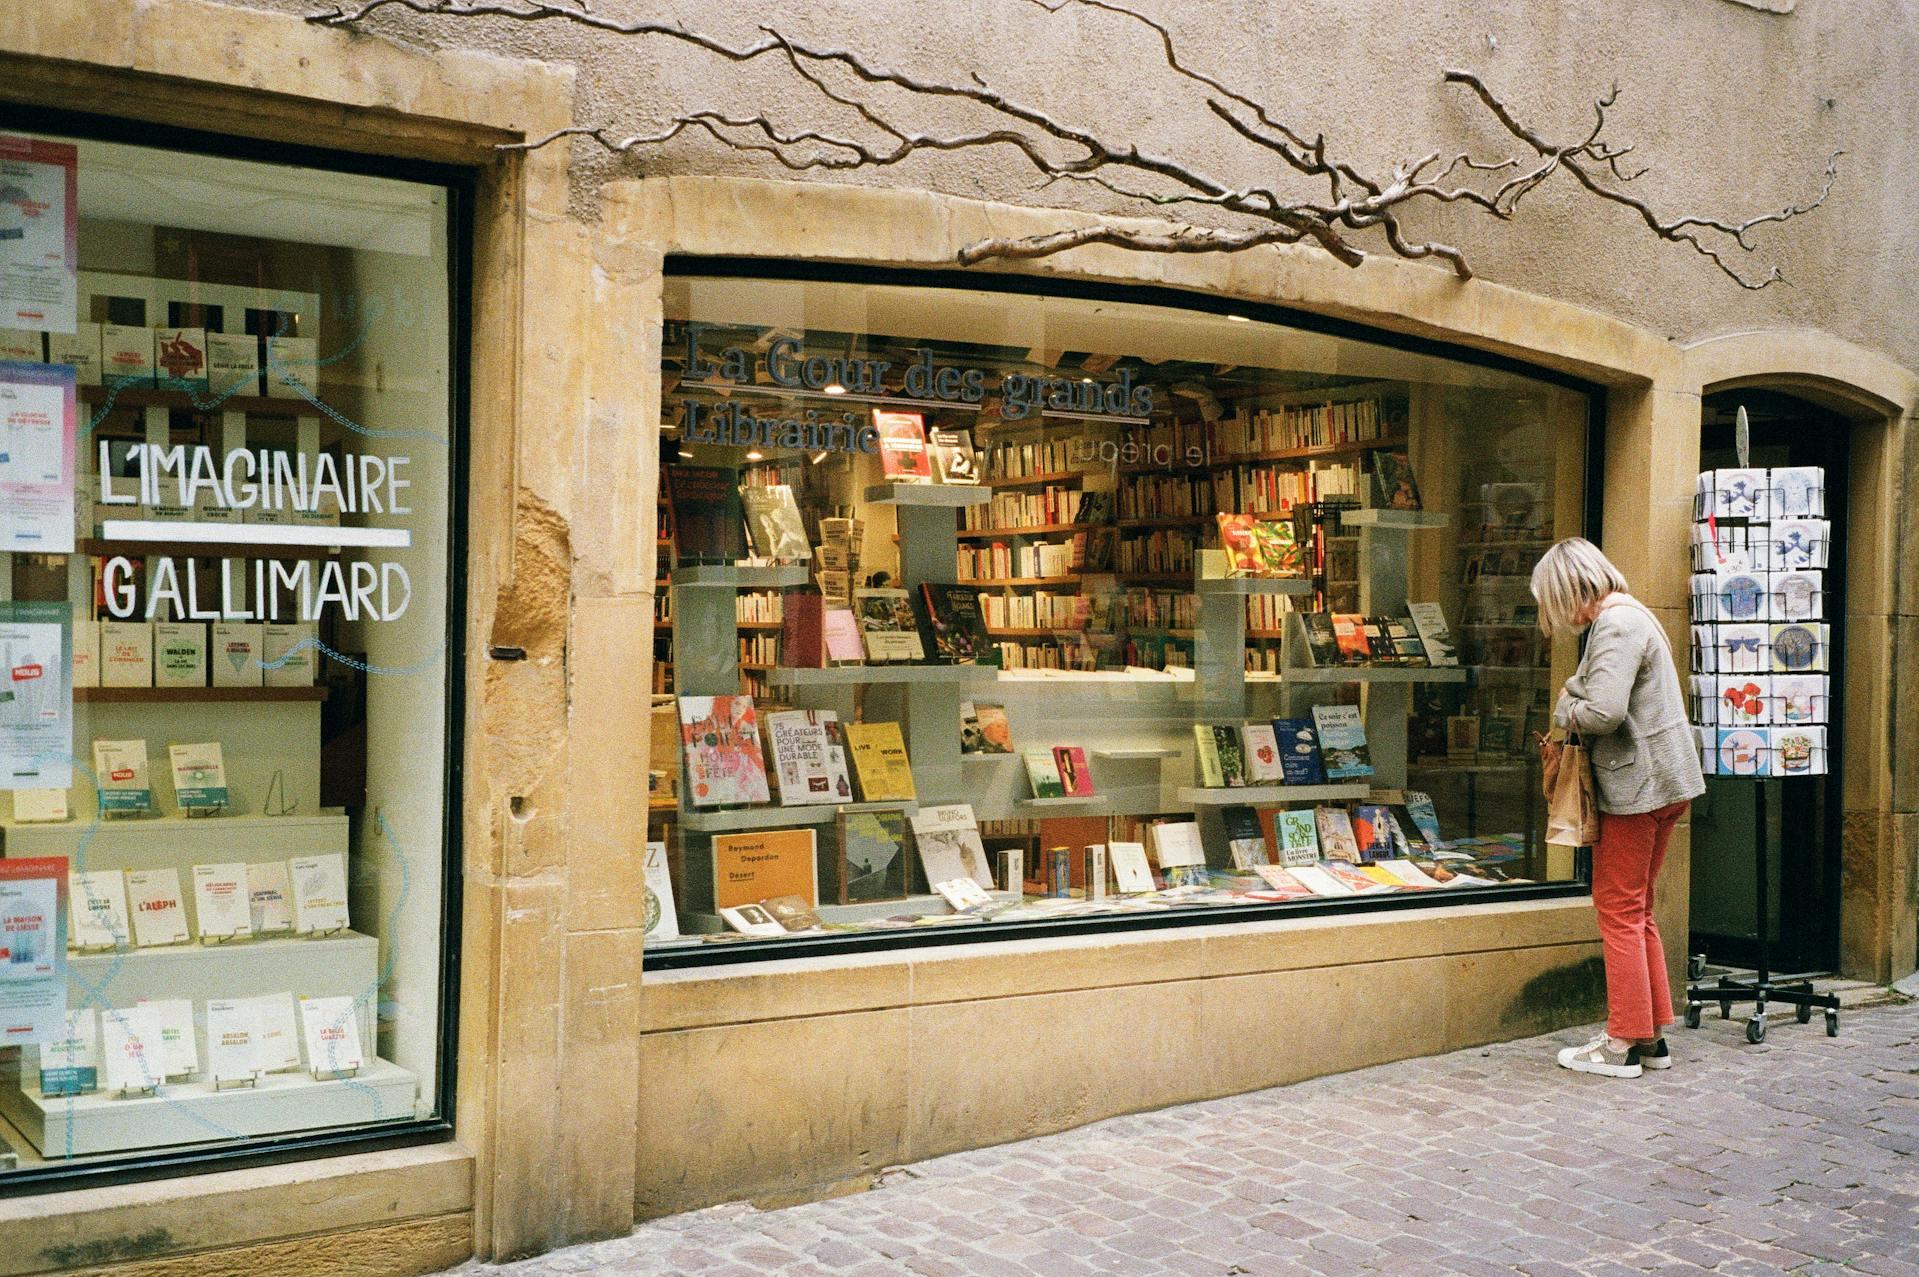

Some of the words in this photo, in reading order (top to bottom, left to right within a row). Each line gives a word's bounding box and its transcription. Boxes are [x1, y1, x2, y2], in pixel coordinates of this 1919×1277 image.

[682, 327, 748, 382] La
[765, 338, 892, 393] Cour
[904, 348, 985, 402] des
[1001, 368, 1152, 420] grands
[682, 400, 880, 453] Librairie
[100, 440, 412, 515] L'IMAGINAIRE
[104, 557, 411, 621] GALLIMARD
[774, 722, 785, 730] 75
[775, 727, 823, 738] CRÉATEURS
[776, 738, 800, 746] POUR
[854, 743, 871, 751] LIVE
[778, 745, 796, 753] UNE
[798, 743, 823, 752] MODE
[881, 748, 903, 756] WORK
[779, 751, 819, 762] DURABLE
[728, 843, 764, 852] Raymond
[741, 854, 779, 863] Depardon
[729, 871, 755, 879] Desert
[139, 899, 177, 911] L'ALEPH
